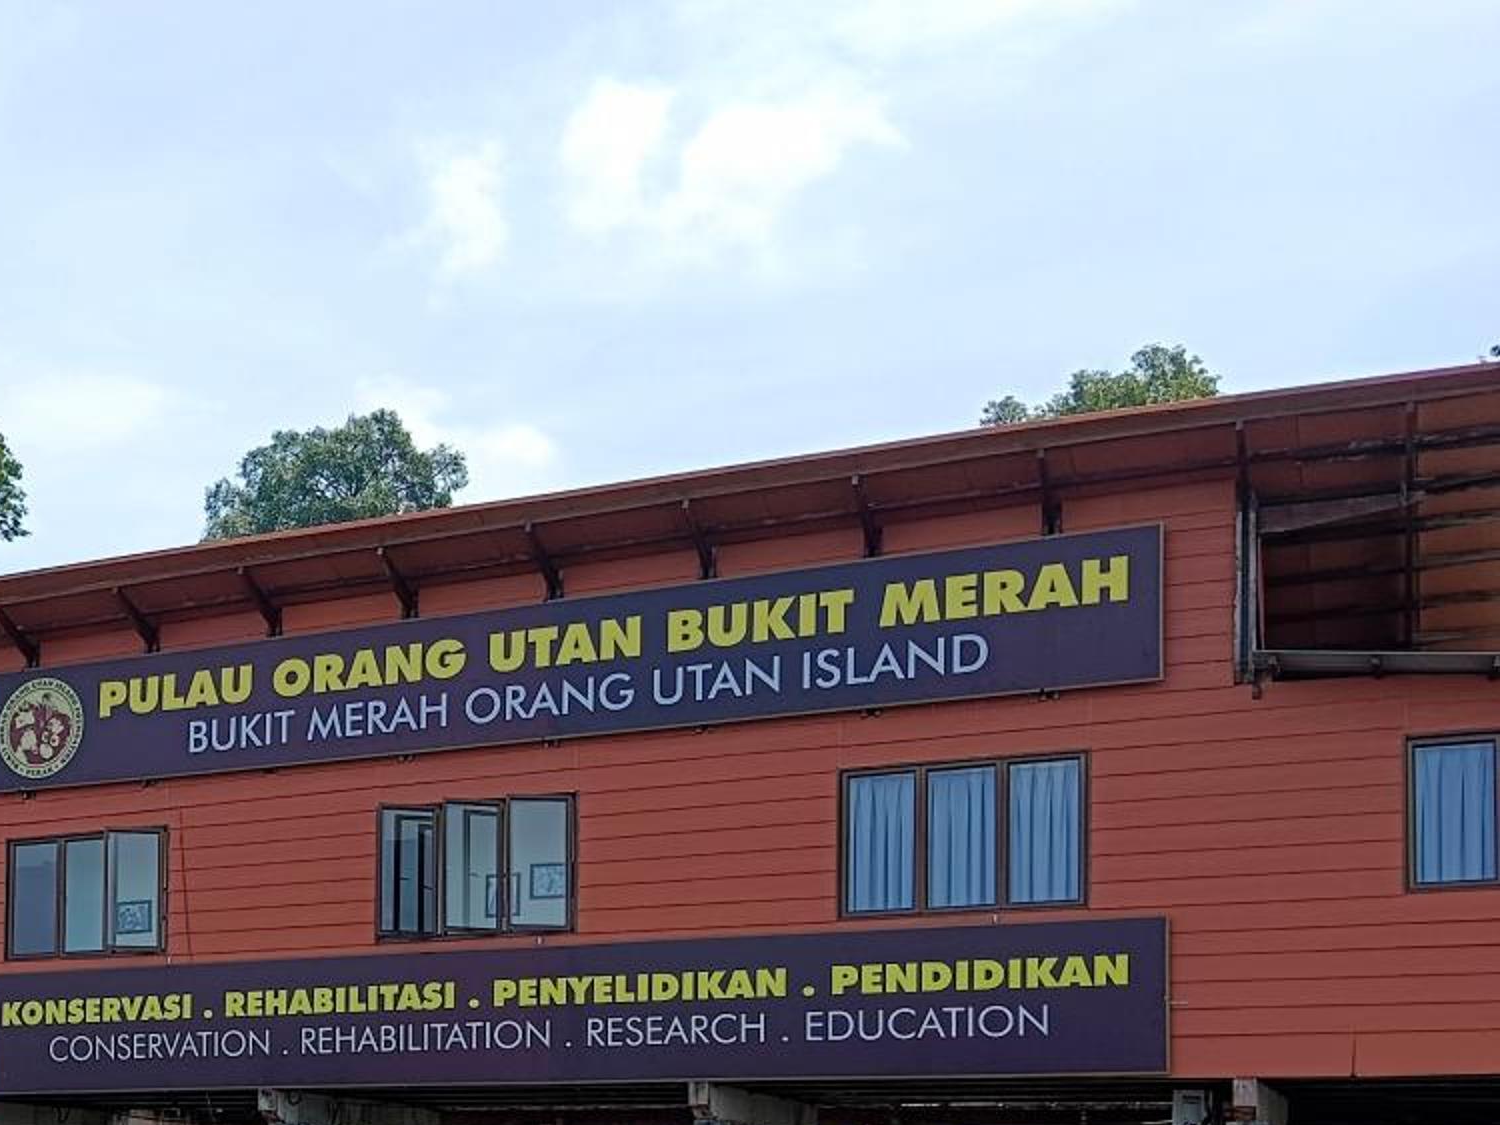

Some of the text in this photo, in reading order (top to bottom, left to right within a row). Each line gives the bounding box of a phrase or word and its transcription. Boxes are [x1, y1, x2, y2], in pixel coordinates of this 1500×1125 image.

[99, 556, 1129, 715] PULAU ORANG UTAN BUKIT MERAH
[189, 634, 988, 753] BUKIT MERAH ORANG UTAN ISLAND
[2, 954, 1129, 1026] KONSERVASI REHABILITASI PENYELIDIKAN PENDIDIKAN
[49, 1004, 1048, 1062] CONSERVATION REHABILITATION RESEARCH EDUCATION
